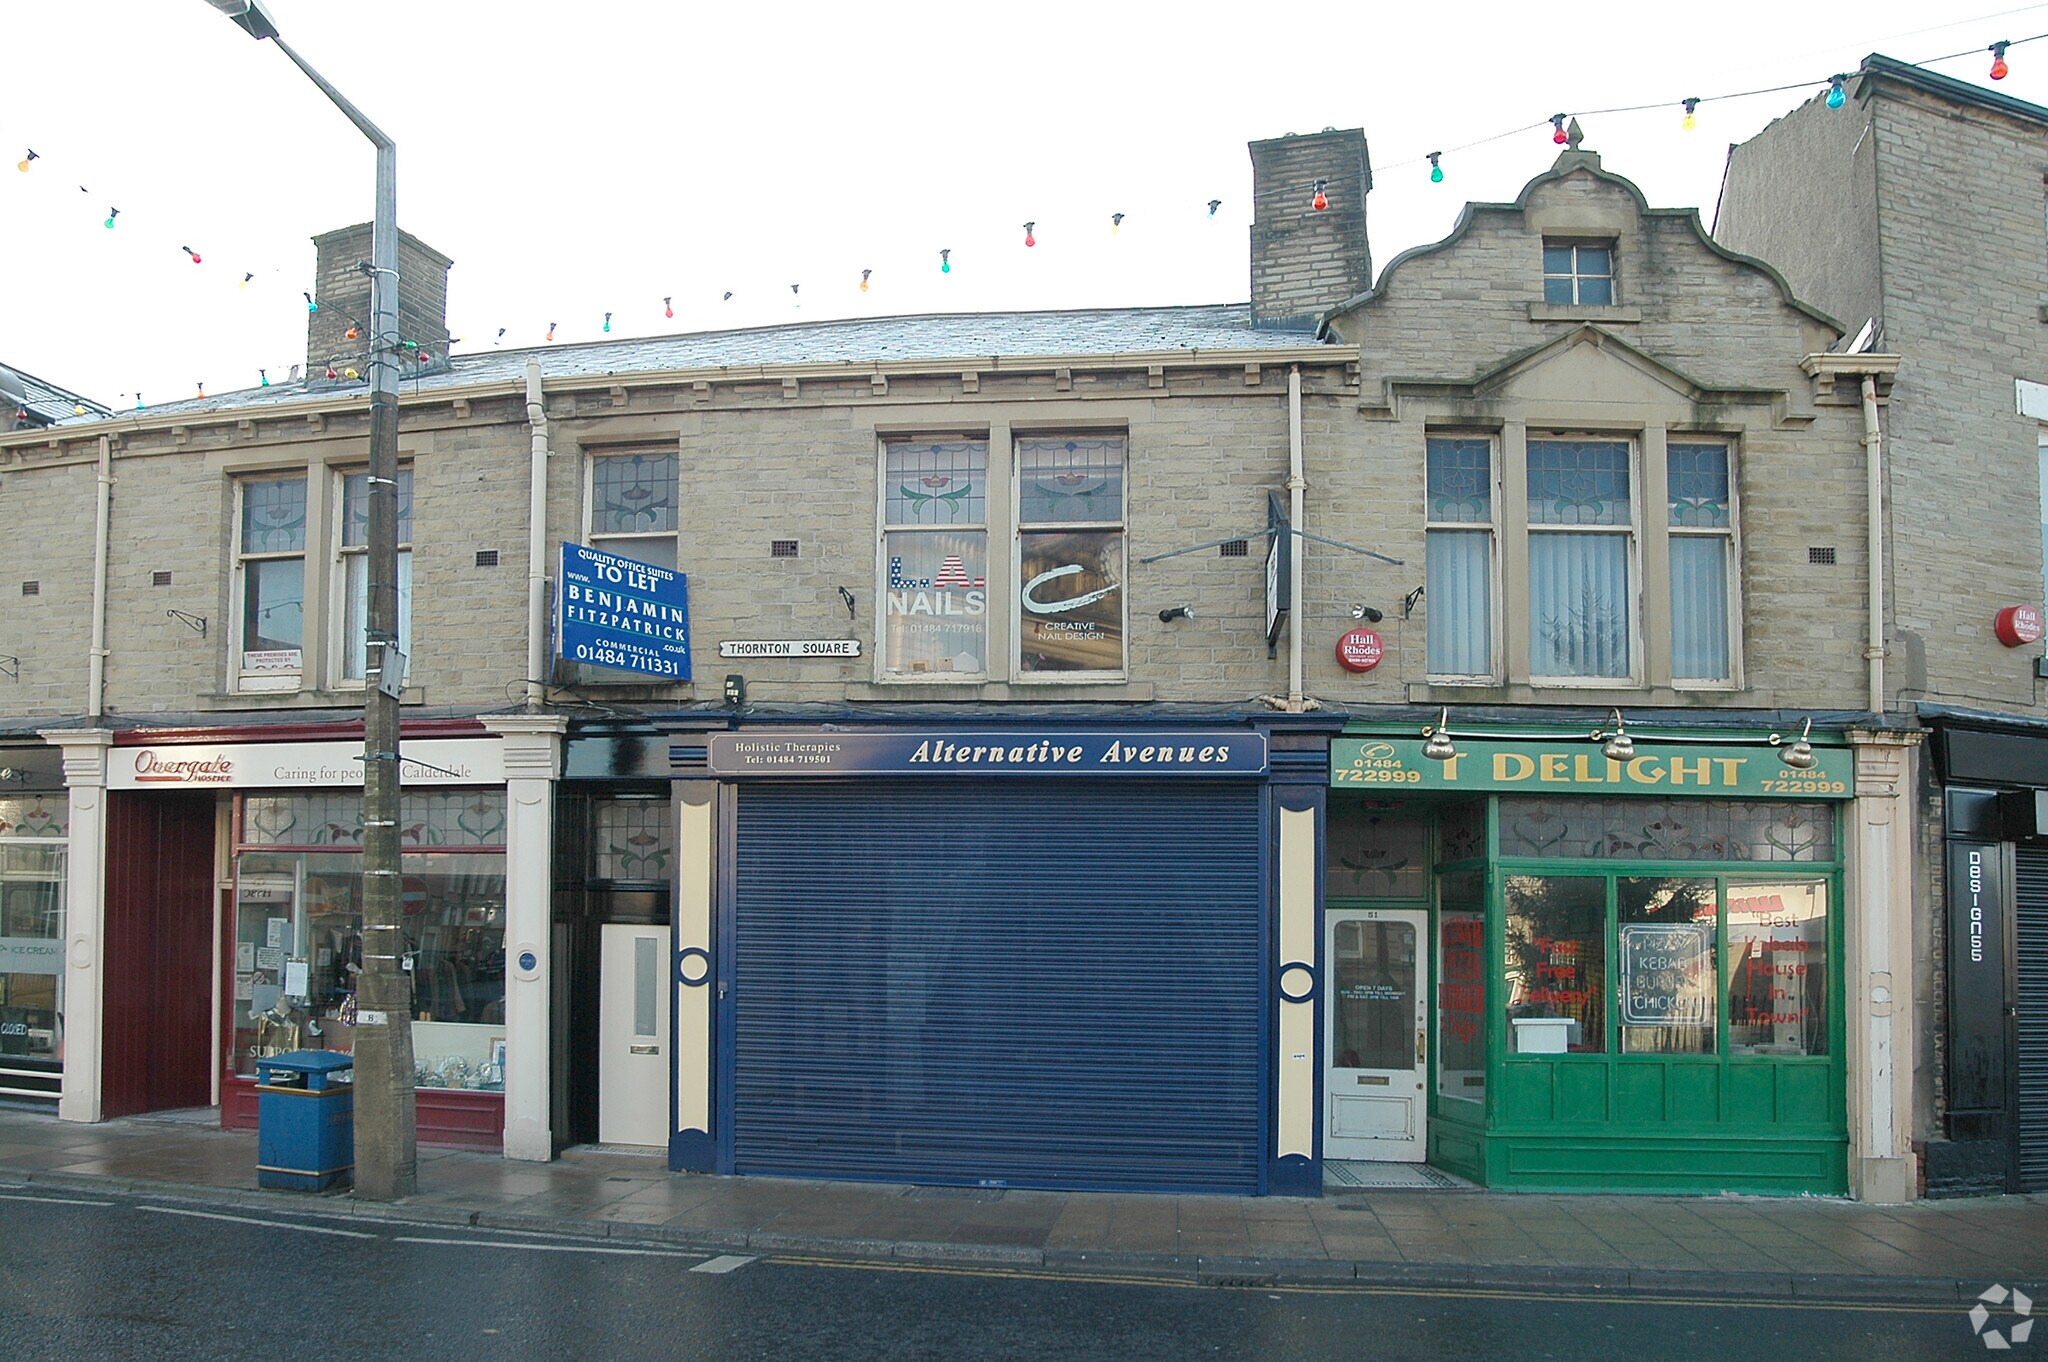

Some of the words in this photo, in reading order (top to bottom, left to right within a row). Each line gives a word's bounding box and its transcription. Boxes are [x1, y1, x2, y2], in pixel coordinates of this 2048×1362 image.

[578, 549, 616, 566] QUALITY
[617, 559, 645, 574] OFFICE
[647, 566, 674, 581] SUITES
[594, 561, 622, 583] TO
[628, 570, 659, 593] LET
[568, 584, 683, 624] BENJAMIN
[887, 591, 986, 616] NAILS
[567, 604, 685, 641] FITZPATRICK
[2019, 610, 2036, 621] Hall
[1044, 622, 1095, 631] CREATIVE
[1065, 632, 1104, 640] DESIGN
[1350, 634, 1373, 644] Hall
[595, 638, 660, 657] COMMERCIAL
[730, 643, 790, 654] THORNTON
[803, 643, 850, 654] SQUARE
[1344, 645, 1380, 655] Rhodes
[576, 644, 626, 666] 01484
[630, 654, 679, 675] 711331
[735, 742, 780, 752] Holistic
[784, 742, 841, 754] Therapies
[910, 740, 1083, 763] Alternative
[1100, 740, 1230, 763] Avenues
[135, 750, 232, 782] Overgate
[745, 755, 763, 764] Tel:
[766, 755, 795, 764] 01484
[798, 755, 831, 764] 719501
[1354, 758, 1402, 768] 01484
[274, 766, 317, 782] Caring
[320, 765, 337, 779] for
[402, 764, 472, 778] Calderdale
[1335, 768, 1421, 783] 722999
[1492, 753, 1748, 786] DELIGHT
[1778, 770, 1827, 779] 01484
[1760, 780, 1845, 793] 722999
[1536, 961, 1576, 979] Free
[1746, 959, 1807, 977] House
[1769, 984, 1786, 1000] In
